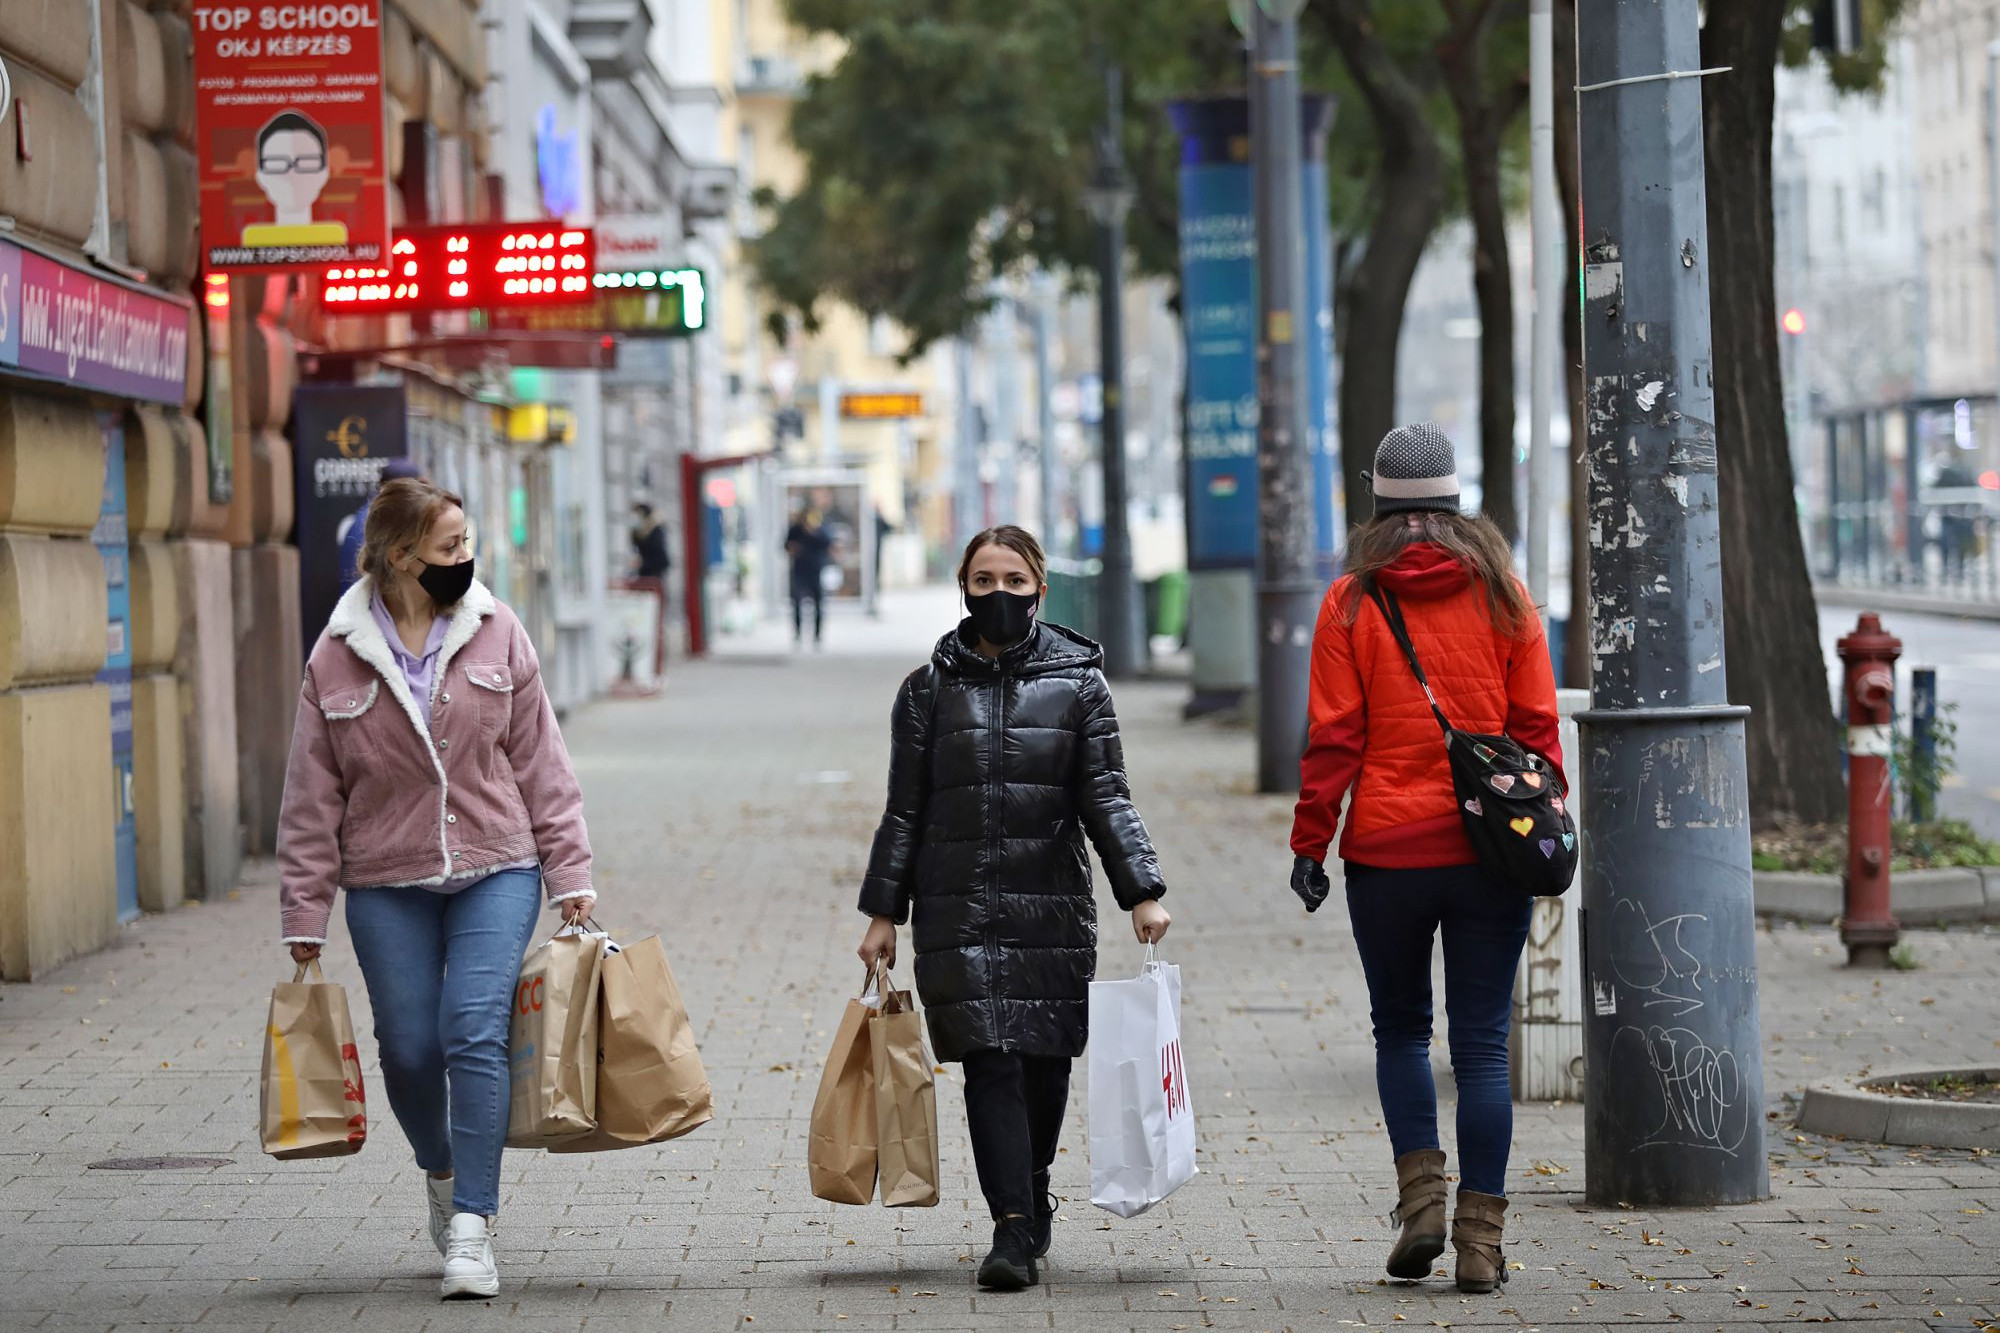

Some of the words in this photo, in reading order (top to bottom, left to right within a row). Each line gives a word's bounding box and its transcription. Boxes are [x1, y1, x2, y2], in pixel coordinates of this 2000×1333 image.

[195, 7, 252, 32] TOP
[259, 4, 378, 31] SCHOOL
[216, 37, 261, 58] OKJ
[266, 32, 352, 56] KÉPZÉS
[210, 244, 380, 265] WWW.TOPSCHOOL.HU
[1161, 1037, 1187, 1123] H&M
